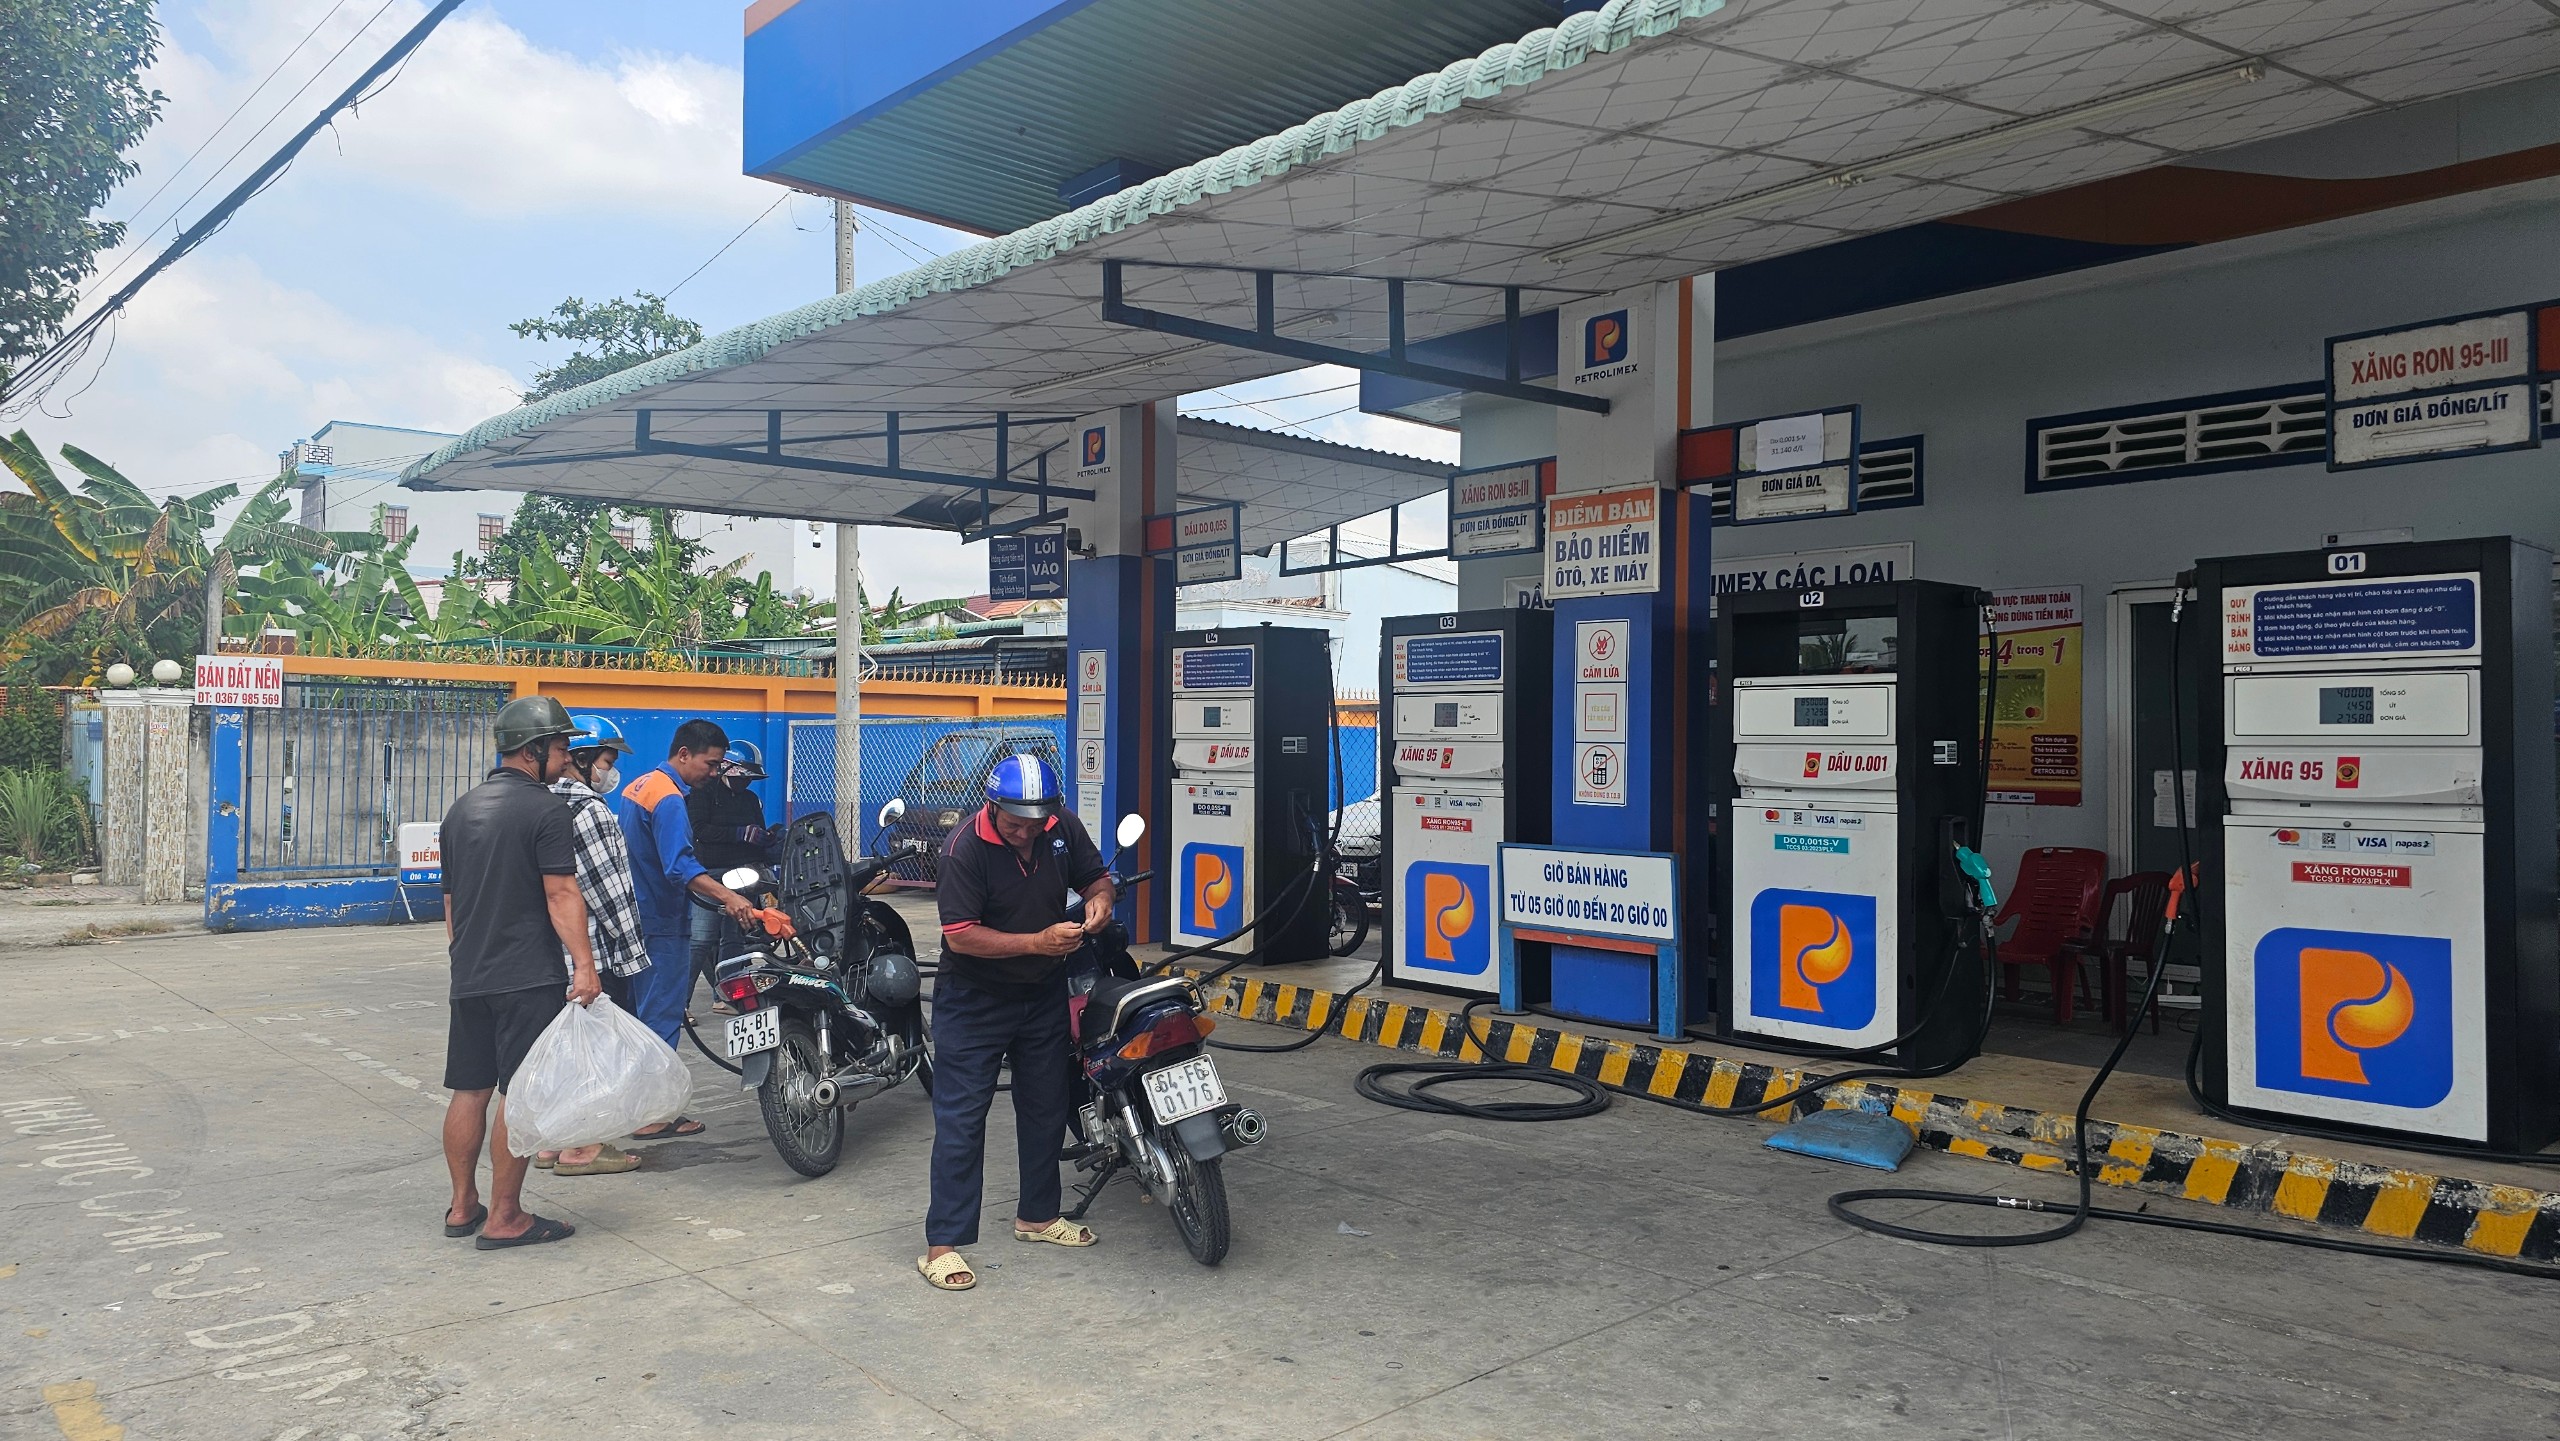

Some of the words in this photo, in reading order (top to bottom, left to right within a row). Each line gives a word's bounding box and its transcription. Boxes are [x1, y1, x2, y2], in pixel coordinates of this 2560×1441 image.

[2351, 352, 2406, 384] XĂNG
[2413, 346, 2454, 375] RON
[2461, 338, 2508, 368] 95-III
[1575, 364, 1638, 384] PETROLIMEX
[2354, 410, 2387, 428] ĐƠN
[2394, 403, 2422, 423] GIÁ
[2428, 392, 2508, 418] ĐỒNG/LÍT
[1077, 466, 1110, 477] PETROLIMEX
[1762, 479, 1782, 492] ĐƠN
[1786, 474, 1802, 489] GIÁ
[1806, 475, 1822, 487] Đ/L
[1462, 484, 1485, 504] XĂNG
[1488, 483, 1505, 500] RON
[1508, 480, 1528, 498] 95-III
[1555, 501, 1603, 527] ĐIỂM
[1608, 498, 1650, 520] BÁN
[1185, 521, 1198, 536] DẦU
[1200, 523, 1208, 534] DO
[1210, 520, 1227, 535] 0,05S
[1460, 521, 1475, 532] ĐƠN
[1478, 518, 1490, 530] GIÁ
[1035, 538, 1055, 554] LỐI
[1555, 532, 1592, 562] BẢO
[1599, 524, 1649, 558] HIỂM
[1183, 550, 1193, 563] ĐƠN
[1195, 550, 1204, 562] GIÁ
[2335, 555, 2360, 571] 01
[1032, 561, 1059, 575] VÀO
[1556, 566, 1586, 587] ÔTÔ,
[1591, 566, 1608, 584] XE
[1614, 560, 1648, 582] MÁY
[1775, 562, 1825, 589] CÁC
[1803, 593, 1821, 604] 02
[2020, 594, 2046, 605] THANH
[2049, 591, 2070, 603] TOÁN
[2231, 599, 2246, 608] QUY
[1442, 618, 1454, 627] 03
[2226, 611, 2250, 623] TRÌNH
[2231, 626, 2248, 637] BÁN
[1997, 640, 2013, 664] 4
[2017, 646, 2044, 656] trong
[2052, 637, 2065, 664] 1
[2229, 641, 2250, 652] HÀNG
[198, 661, 223, 687] BÁN
[228, 659, 251, 688] ĐẤT
[255, 661, 280, 689] NỀN
[1583, 665, 1601, 678] CẤM
[1604, 664, 1619, 678] LỬA
[198, 692, 212, 703] ĐT:
[216, 692, 238, 703] 0367
[242, 693, 259, 704] 985
[262, 694, 279, 705] 569
[2337, 688, 2371, 698] 40000
[1221, 743, 1233, 758] DẦU
[1235, 747, 1249, 758] 0.05
[1400, 746, 1424, 761] XĂNG
[1427, 749, 1437, 761] 95
[1828, 751, 1851, 771] DẦU
[1855, 755, 1887, 771] 0.001
[2240, 757, 2293, 780] XĂNG
[2300, 761, 2323, 780] 95
[1815, 816, 1835, 824] VISA
[2356, 837, 2387, 848] VISA
[412, 847, 439, 862] ĐIỂM
[1544, 860, 1563, 883] GIỜ
[1567, 862, 1590, 885] BÁN
[1594, 864, 1628, 888] HÀNG
[2304, 864, 2338, 875] XĂNG
[2342, 867, 2398, 878] RON95-III
[2311, 875, 2333, 883] TCCS
[2352, 877, 2391, 885] 2023/PLX
[1511, 890, 1525, 912] TỪ
[1529, 896, 1541, 914] 05
[1544, 894, 1564, 916] GIỜ
[1568, 900, 1580, 918] 00
[1583, 895, 1607, 921] ĐẾN
[1611, 904, 1624, 923] 20
[1628, 902, 1649, 926] GIỜ
[1653, 908, 1667, 927] 00
[729, 1028, 775, 1055] 179.35
[1163, 1082, 1213, 1114] 0176
